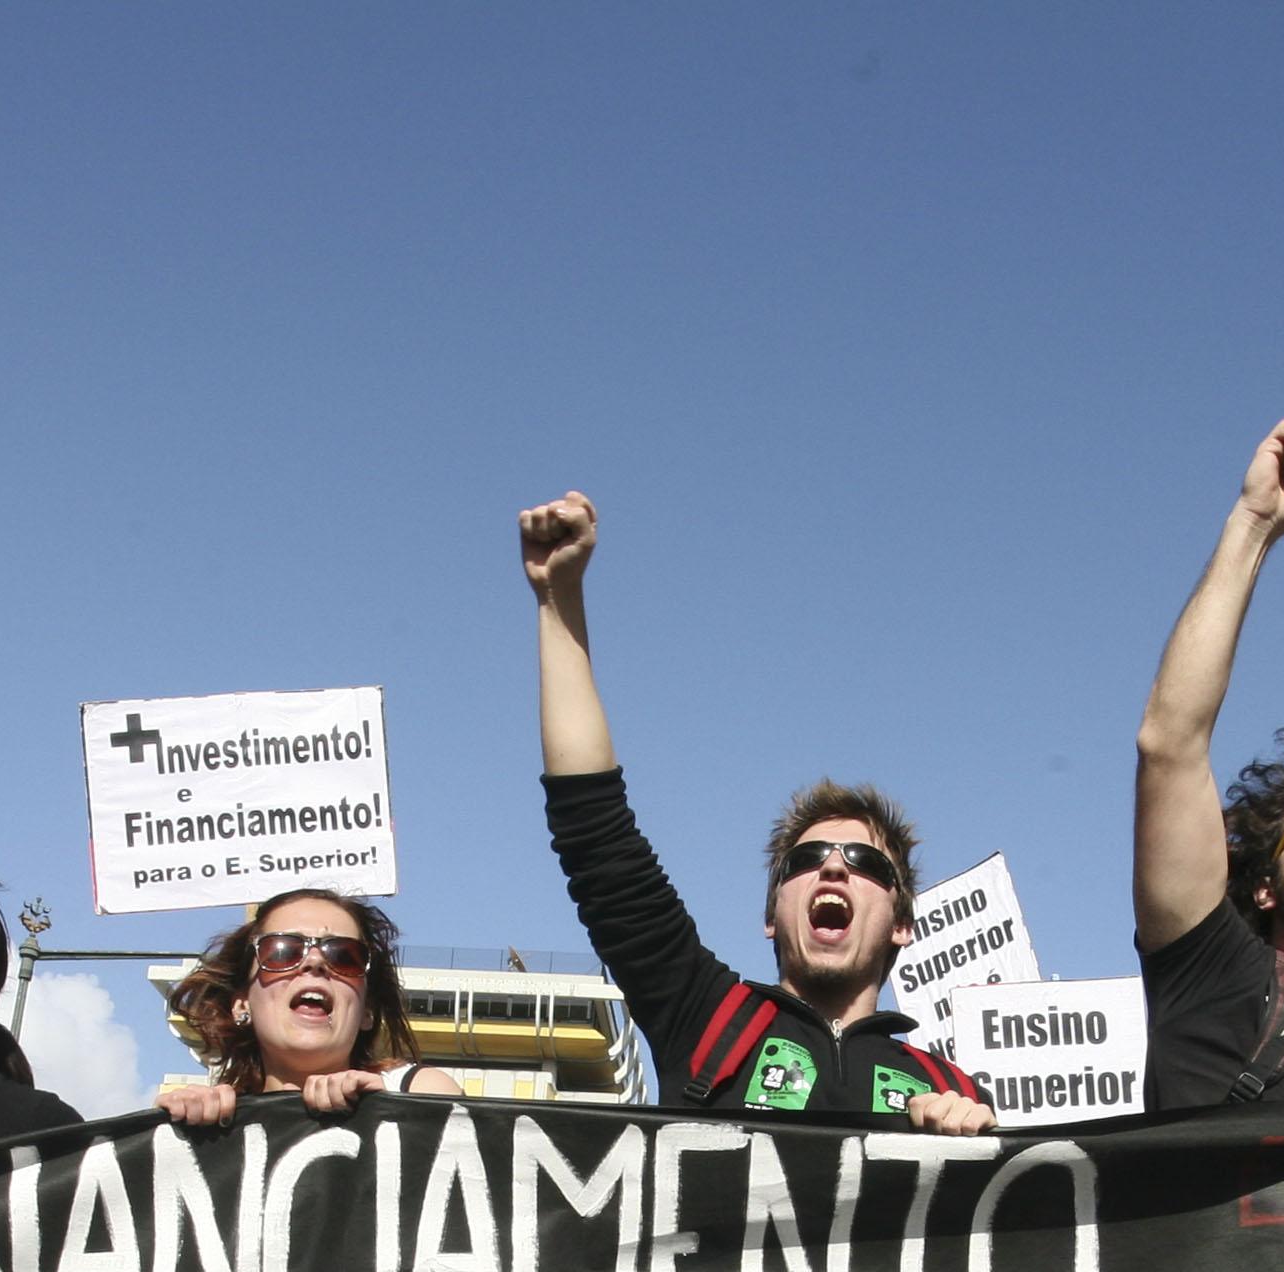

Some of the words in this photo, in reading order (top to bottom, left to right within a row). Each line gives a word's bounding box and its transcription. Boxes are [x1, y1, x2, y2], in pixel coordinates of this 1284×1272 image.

[177, 786, 192, 802] e
[124, 793, 383, 847] Financiamento!
[133, 866, 192, 888] para
[201, 861, 216, 878] o
[225, 856, 250, 875] E.
[259, 846, 378, 874] Superior!
[905, 888, 987, 949] nsino
[899, 917, 1015, 993] Superior
[982, 1005, 1107, 1050] Ensino
[766, 1067, 785, 1083] 24
[972, 1066, 1136, 1114] Superior
